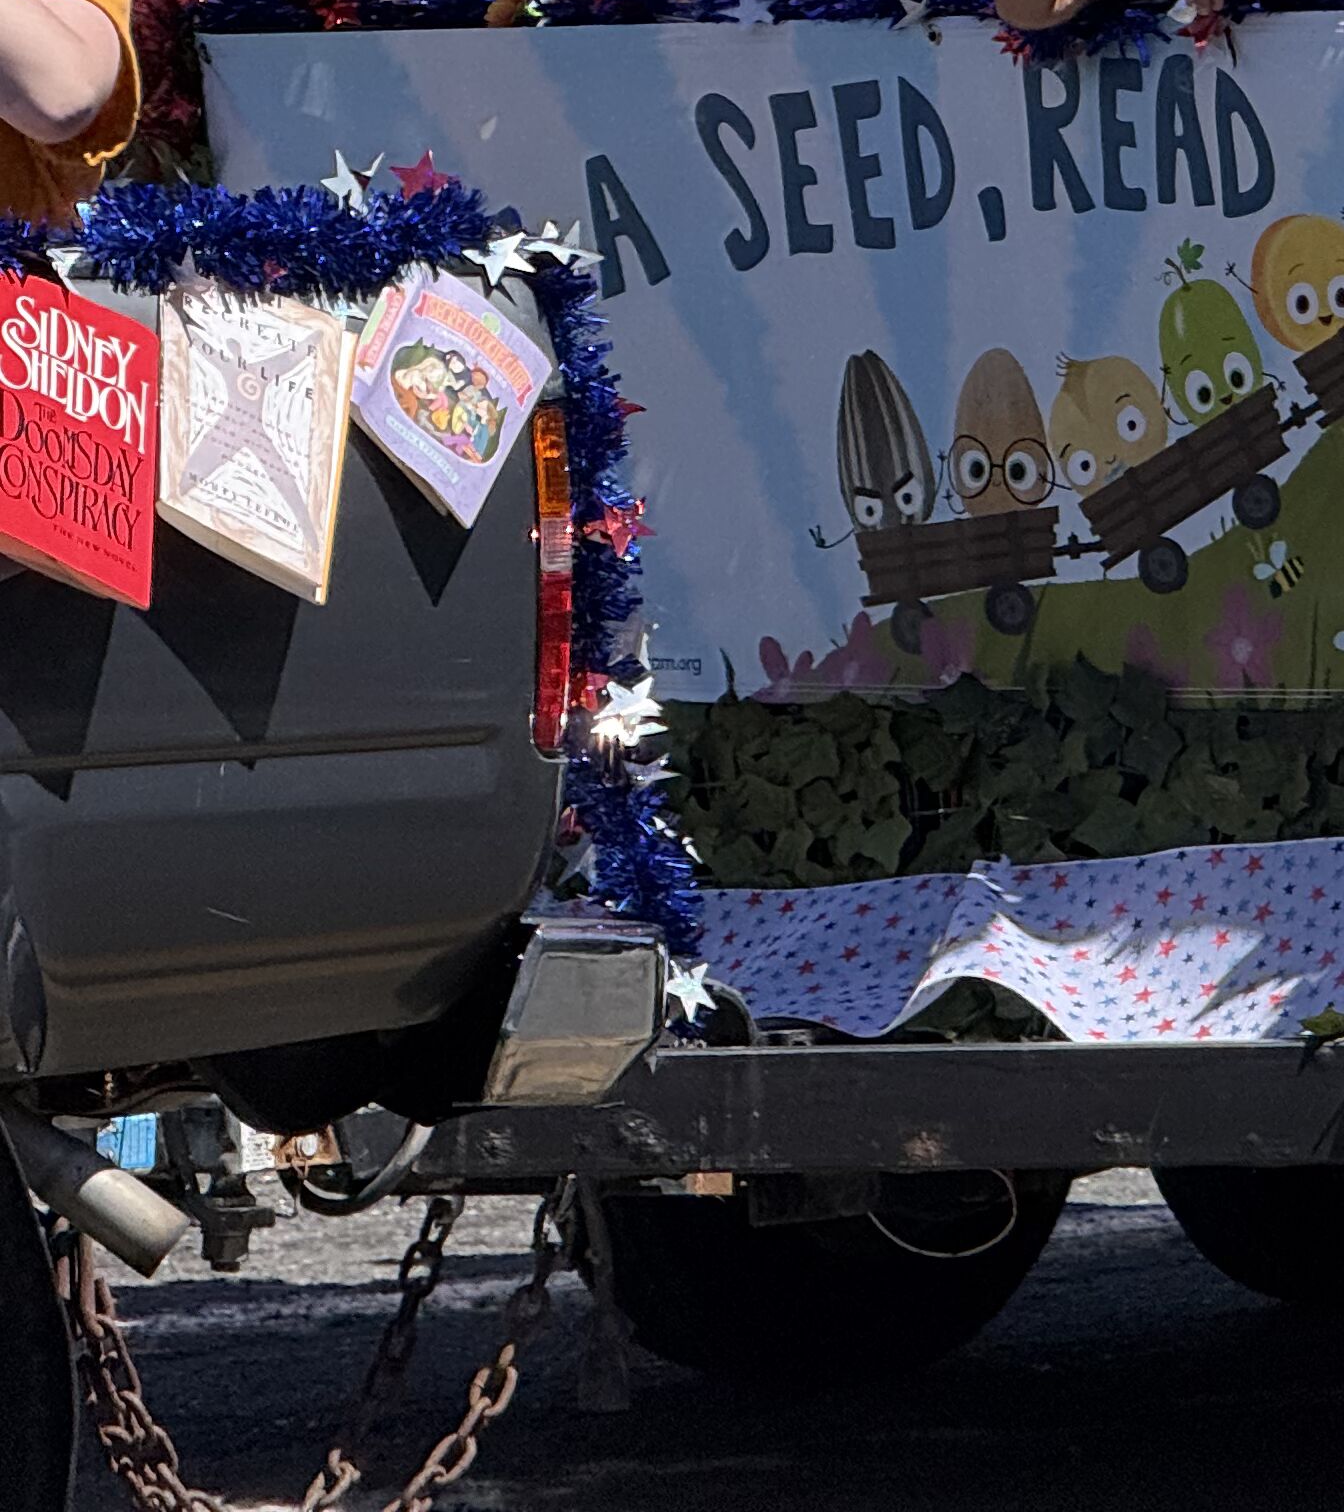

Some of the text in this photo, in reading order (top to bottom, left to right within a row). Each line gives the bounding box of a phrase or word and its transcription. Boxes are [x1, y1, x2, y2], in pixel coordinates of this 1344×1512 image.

[585, 54, 1276, 300] A SEED, READ
[0, 319, 149, 456] SHELDON
[11, 295, 139, 390] SIDNEY
[259, 365, 315, 401] LIFE
[0, 390, 144, 506] DOOMSDAY
[34, 400, 57, 425] THE
[0, 443, 141, 552] CONSPIRACY
